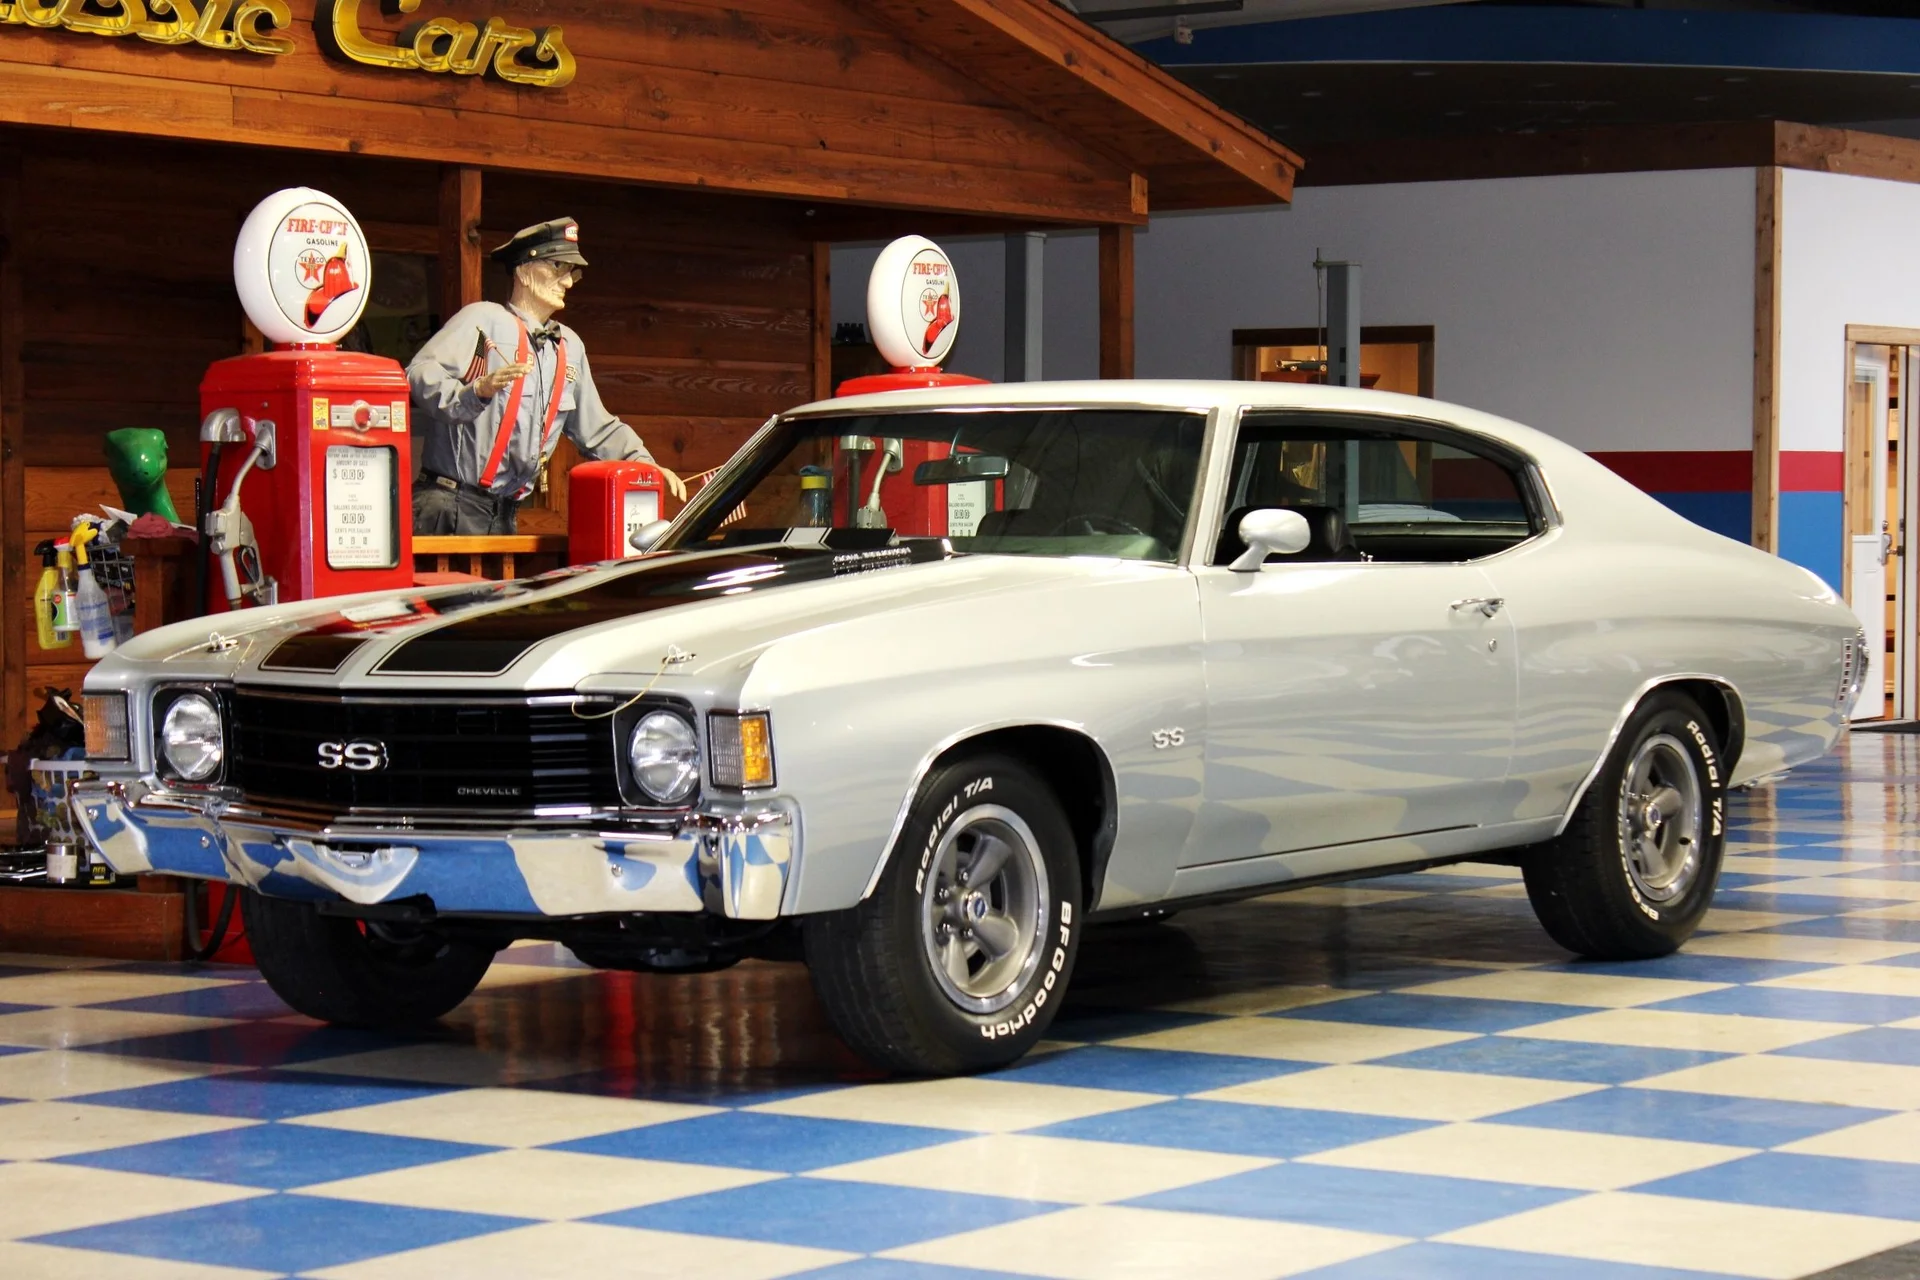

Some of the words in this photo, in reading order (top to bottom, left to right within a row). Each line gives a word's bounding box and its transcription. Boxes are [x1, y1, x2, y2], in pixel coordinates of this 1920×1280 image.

[331, 0, 576, 87] Cars
[306, 238, 339, 247] GASOLINE
[318, 741, 381, 771] SS
[1151, 726, 1185, 749] SS
[457, 787, 521, 796] CHEVELLE
[1686, 720, 1721, 788] Radial
[1711, 797, 1723, 837] T/A
[915, 795, 958, 895] Radial
[963, 776, 994, 799] T/A
[980, 901, 1073, 1040] BFGoodrich
